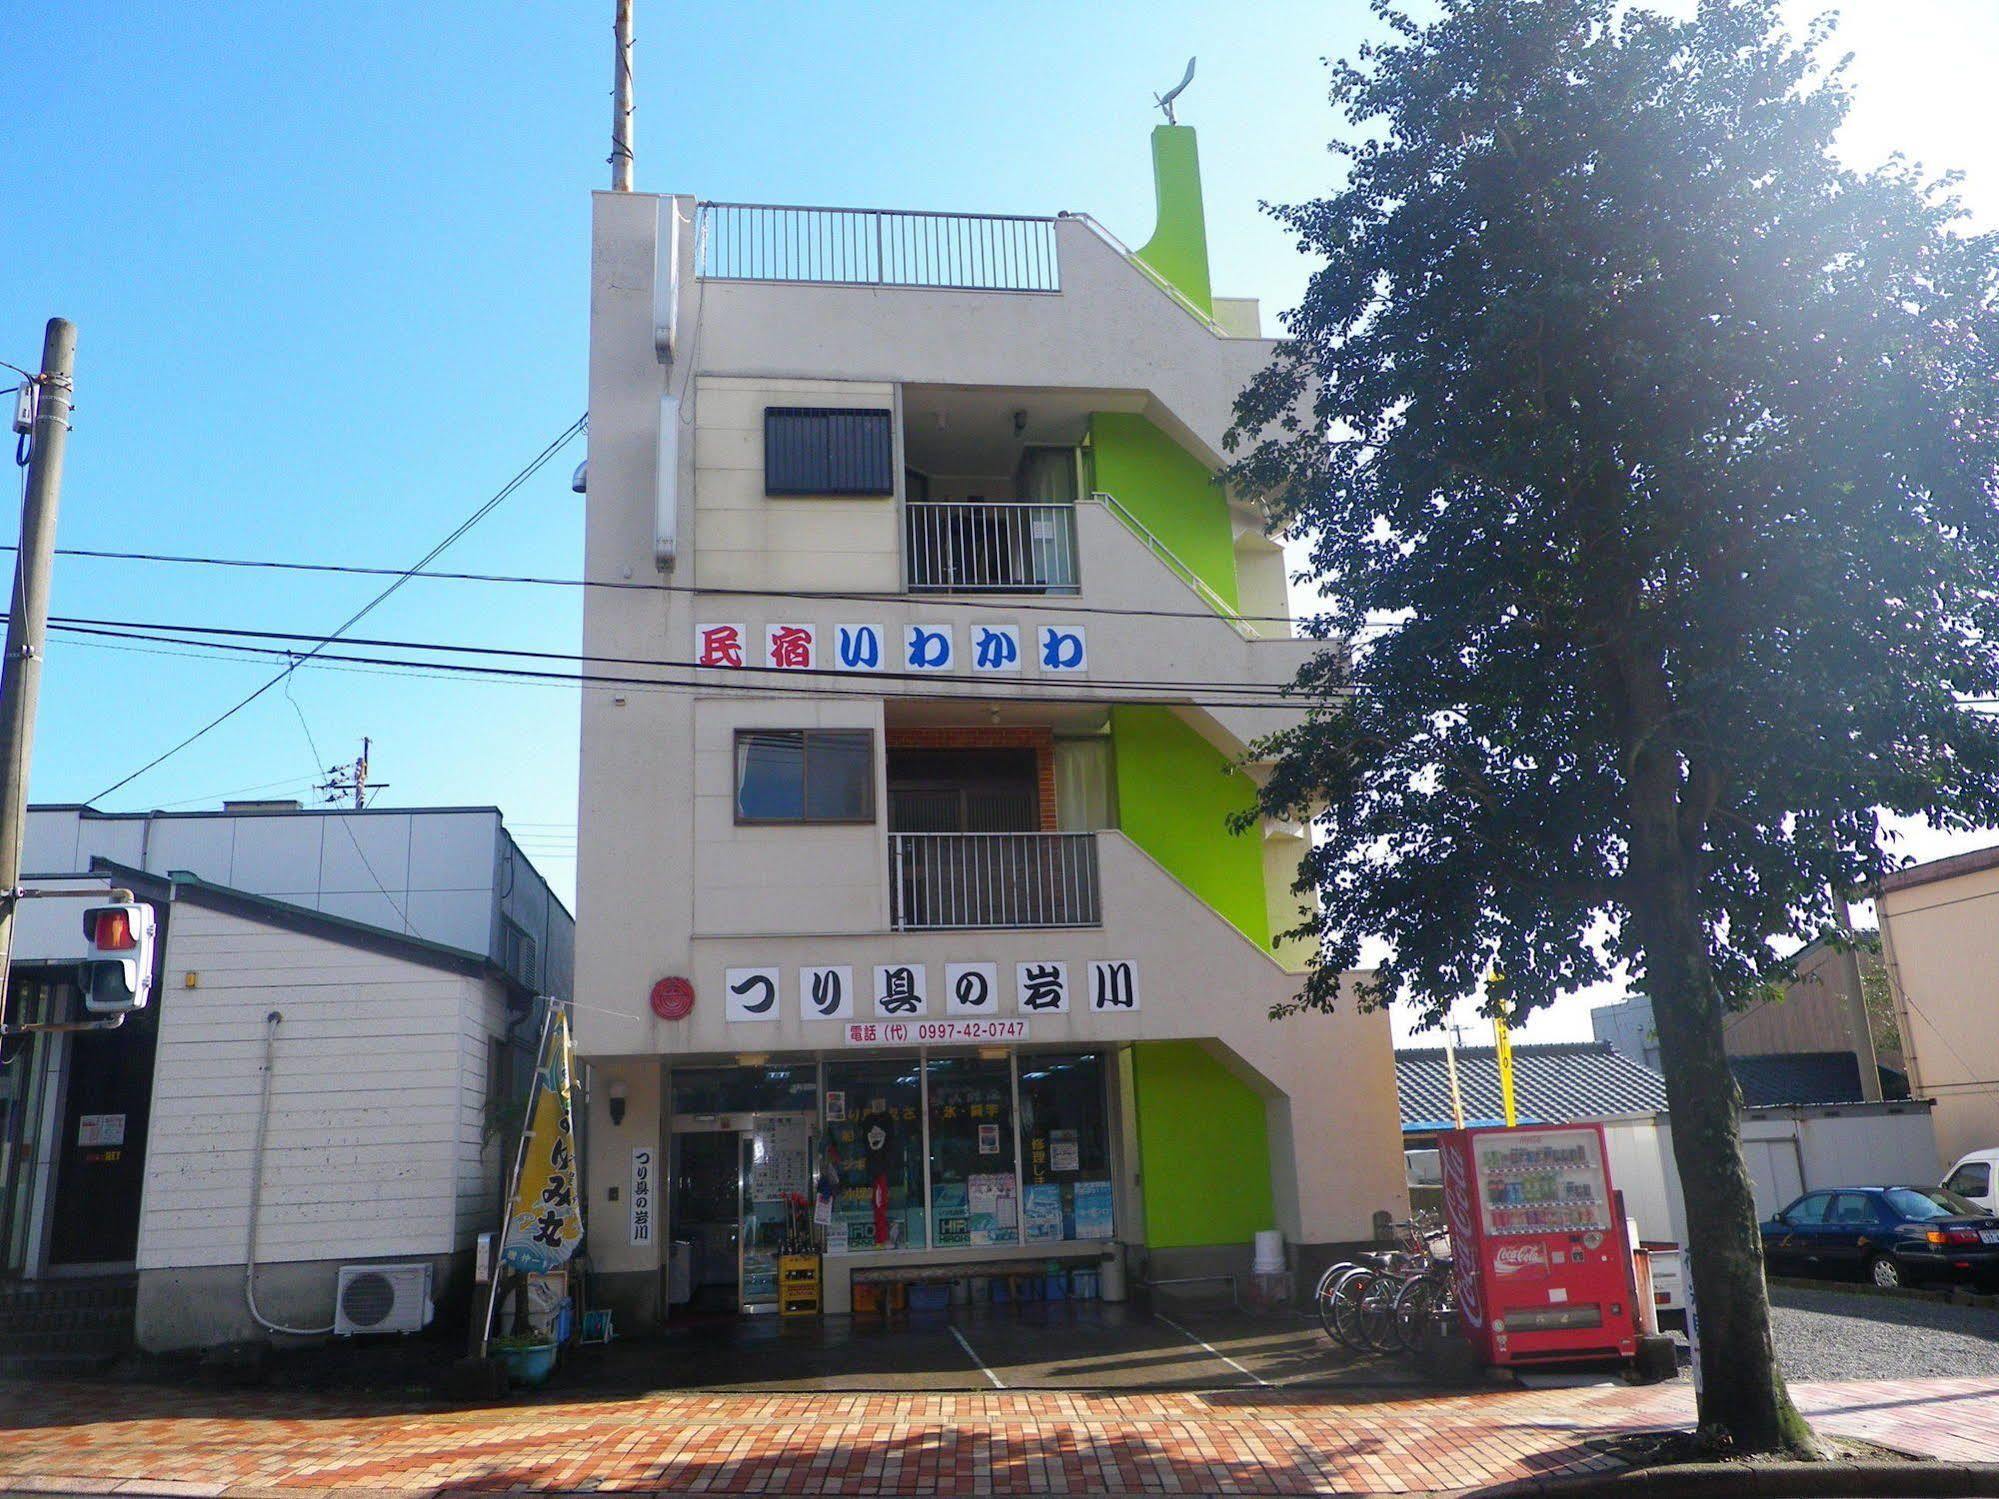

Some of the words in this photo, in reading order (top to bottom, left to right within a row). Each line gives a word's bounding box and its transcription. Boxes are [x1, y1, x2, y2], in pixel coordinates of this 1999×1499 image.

[700, 626, 1084, 668] 民宿いわかわ
[730, 963, 1135, 1013] つり具の岩川
[919, 1022, 1025, 1039] 0997-42-0747
[634, 1152, 650, 1240] つり具の岩川
